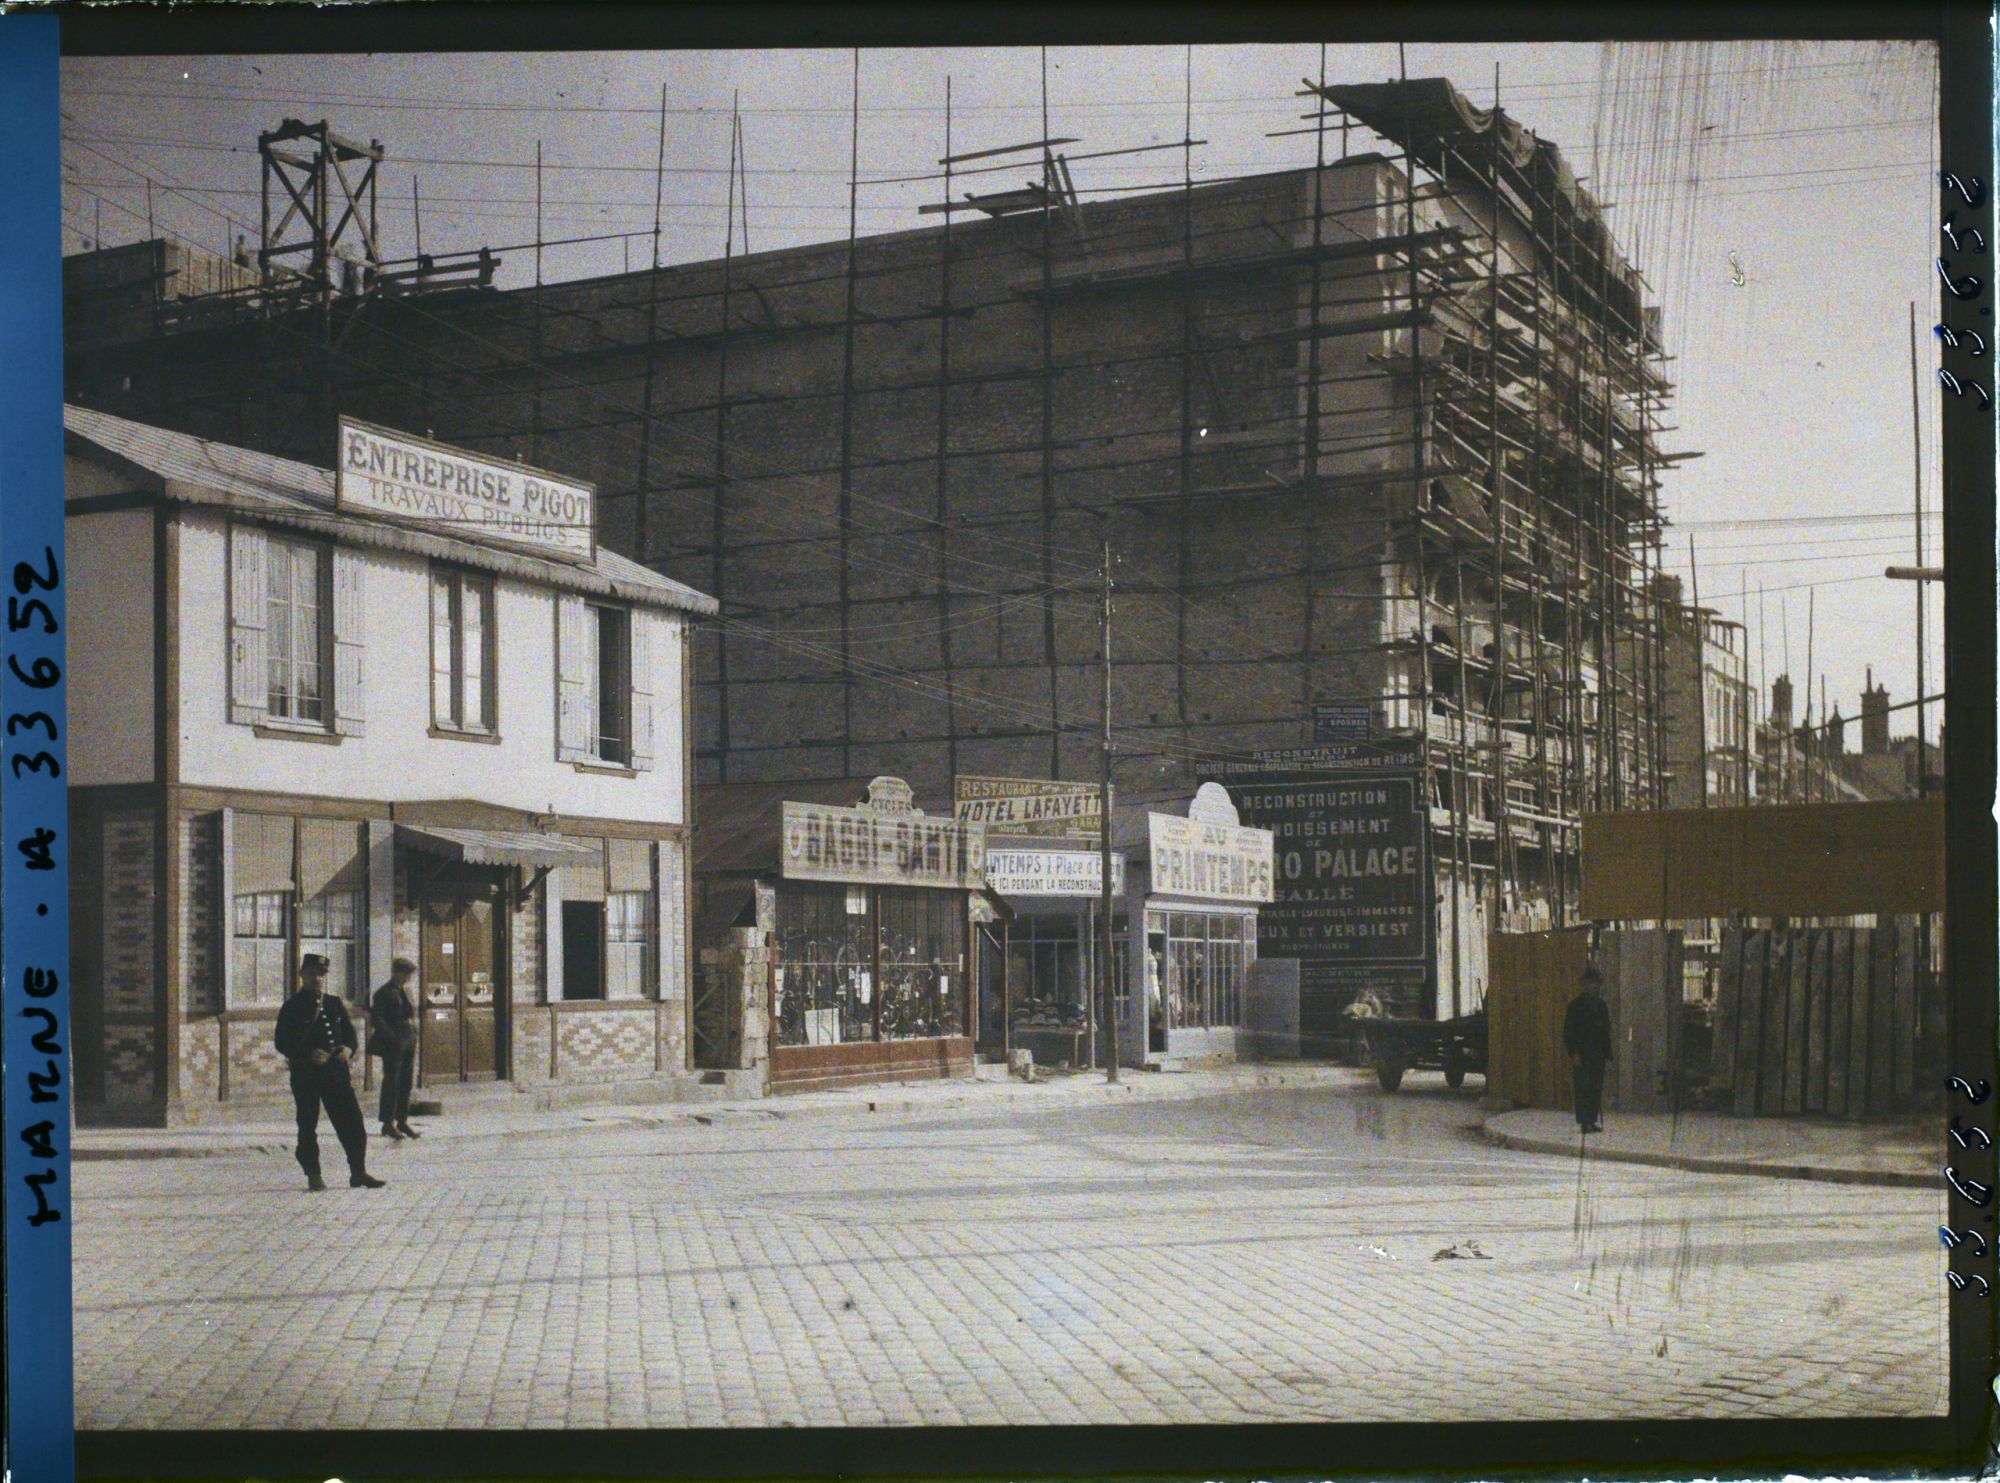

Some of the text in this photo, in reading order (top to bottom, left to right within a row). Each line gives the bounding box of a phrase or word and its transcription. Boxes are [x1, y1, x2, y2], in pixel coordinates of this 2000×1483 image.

[348, 432, 588, 525] ENTREPRISE PIGOT
[369, 478, 568, 545] TRAVAUX PUBLICS
[7, 546, 61, 780] 33652
[961, 780, 1037, 797] RESTAURANT
[1243, 790, 1387, 809] RECONSTRUCTION
[959, 795, 1101, 822] HOTEL LAFAYETT
[1071, 815, 1101, 828] GARA
[1056, 854, 1084, 875] Place
[1156, 845, 1270, 897] PRINTEMPS
[1315, 846, 1417, 878] PALACE
[1012, 878, 1044, 890] PENDANT
[1047, 878, 1056, 890] LA
[1274, 886, 1355, 902] SALLE
[1323, 923, 1409, 937] VERBIEST
[21, 966, 61, 1227] MARNE
